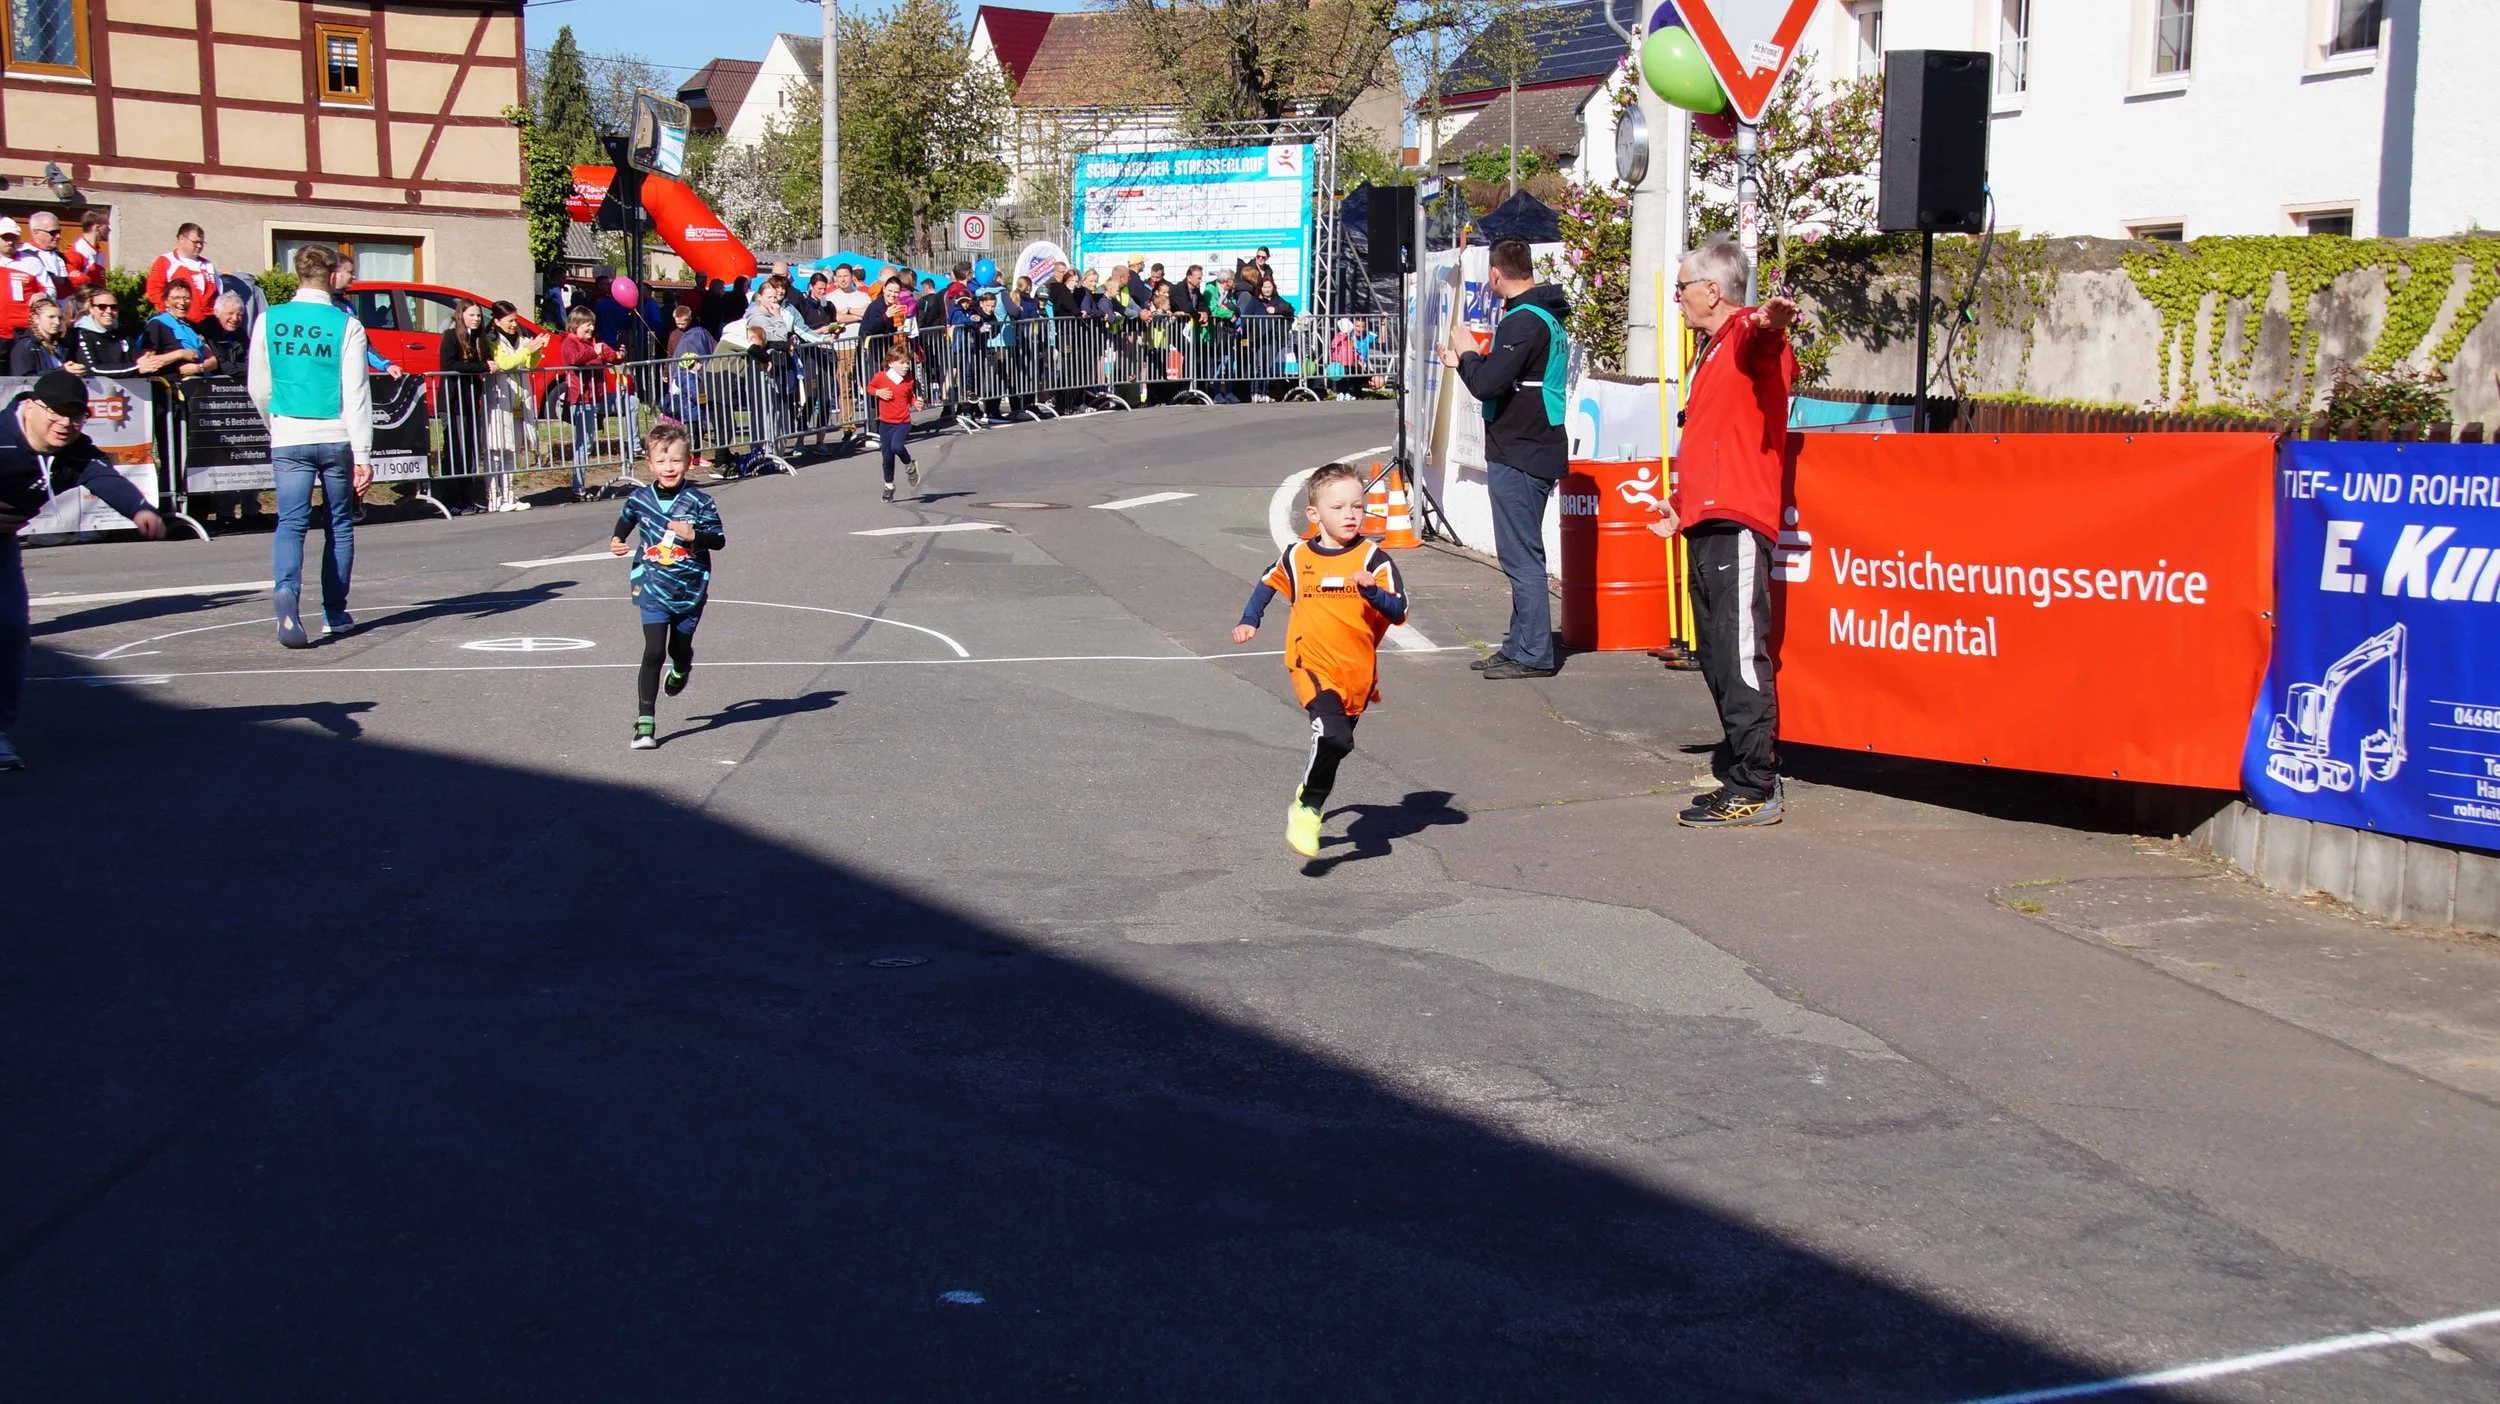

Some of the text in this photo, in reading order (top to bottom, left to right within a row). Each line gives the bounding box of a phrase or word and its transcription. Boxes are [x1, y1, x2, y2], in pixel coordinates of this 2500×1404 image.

[968, 223, 981, 234] 30
[274, 322, 333, 339] ORG-
[273, 341, 332, 358] TEAM
[390, 462, 421, 475] 90009
[2283, 470, 2339, 499] TIEF-
[2342, 472, 2402, 503] UND
[2320, 520, 2368, 594] E.
[1829, 547, 2208, 608] Versicherungsservice
[1829, 607, 1997, 657] Muldental
